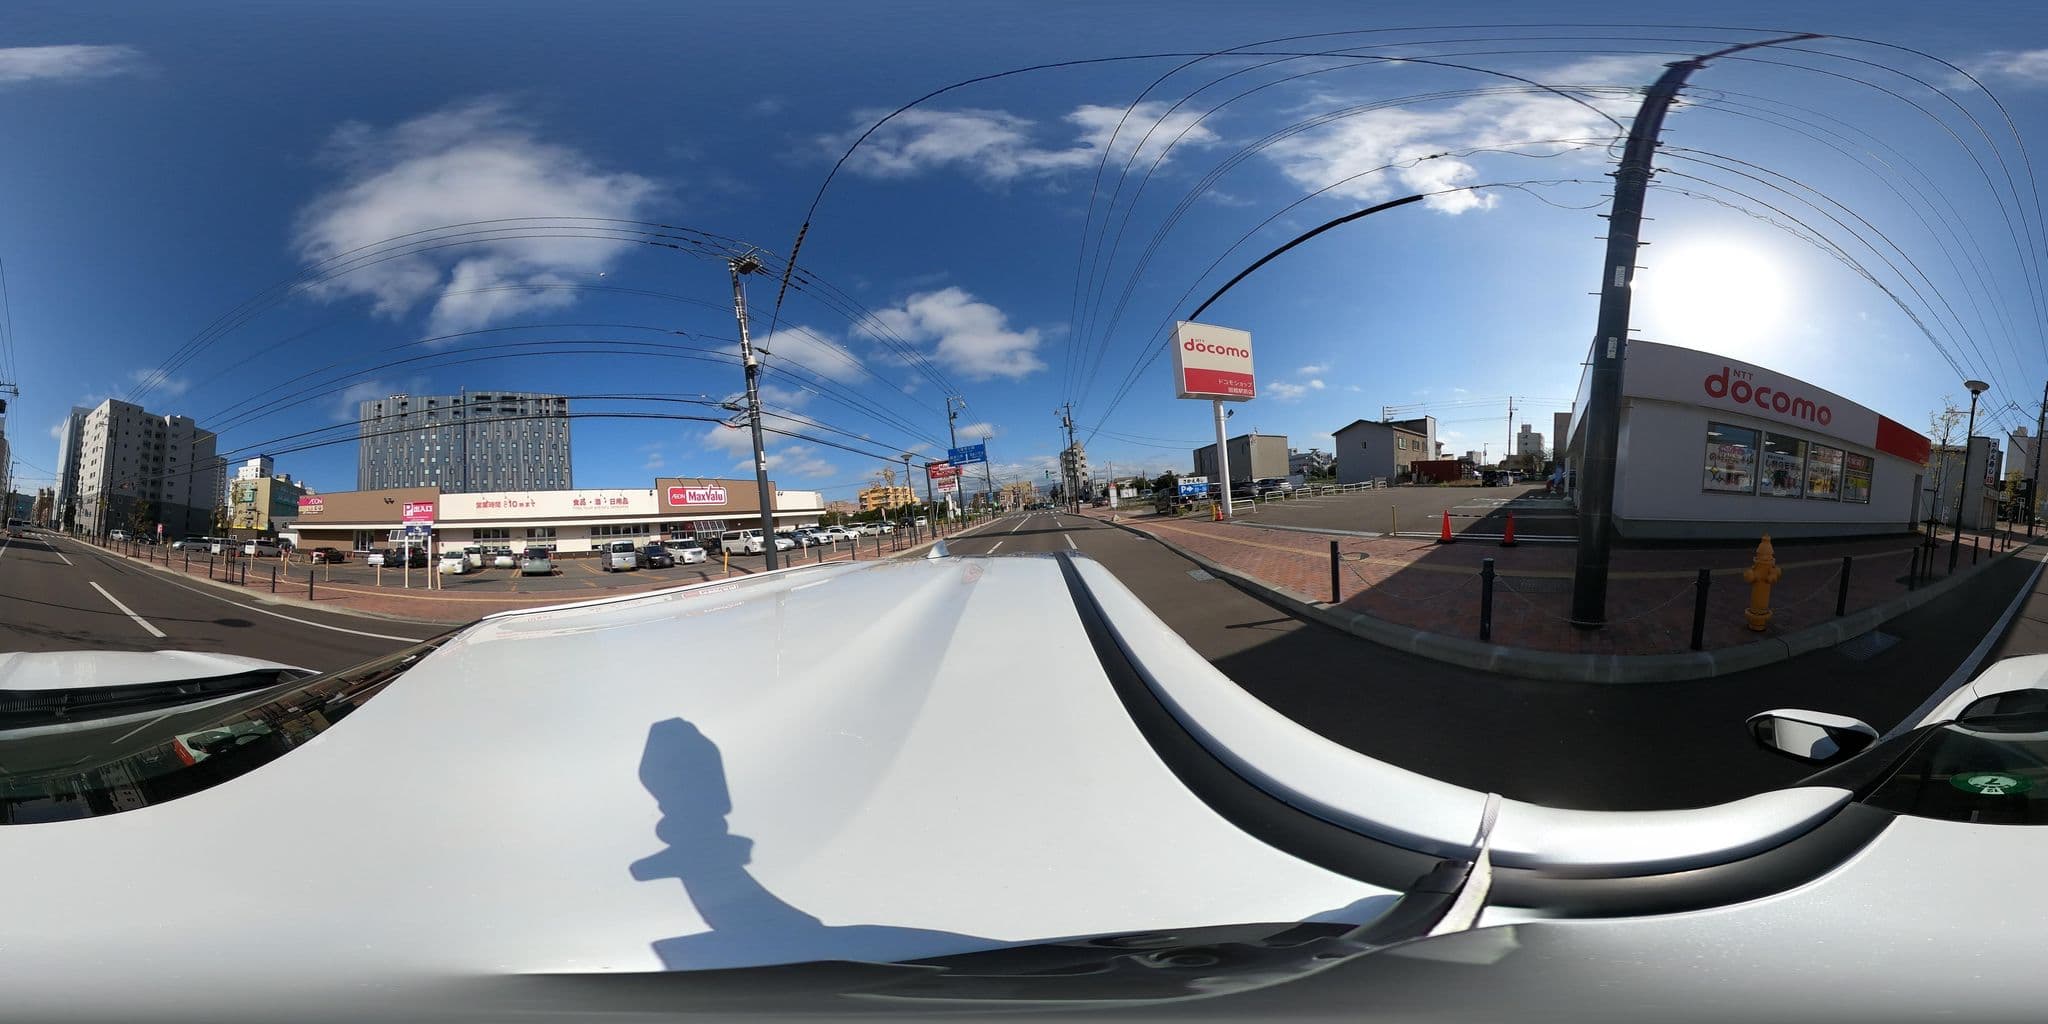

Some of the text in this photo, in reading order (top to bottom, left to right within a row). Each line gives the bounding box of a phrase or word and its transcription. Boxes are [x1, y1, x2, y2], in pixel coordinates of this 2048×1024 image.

[1183, 338, 1249, 358] docomo
[1733, 369, 1753, 381] NTT
[1704, 366, 1832, 426] docomo
[688, 485, 723, 502] MaxValu
